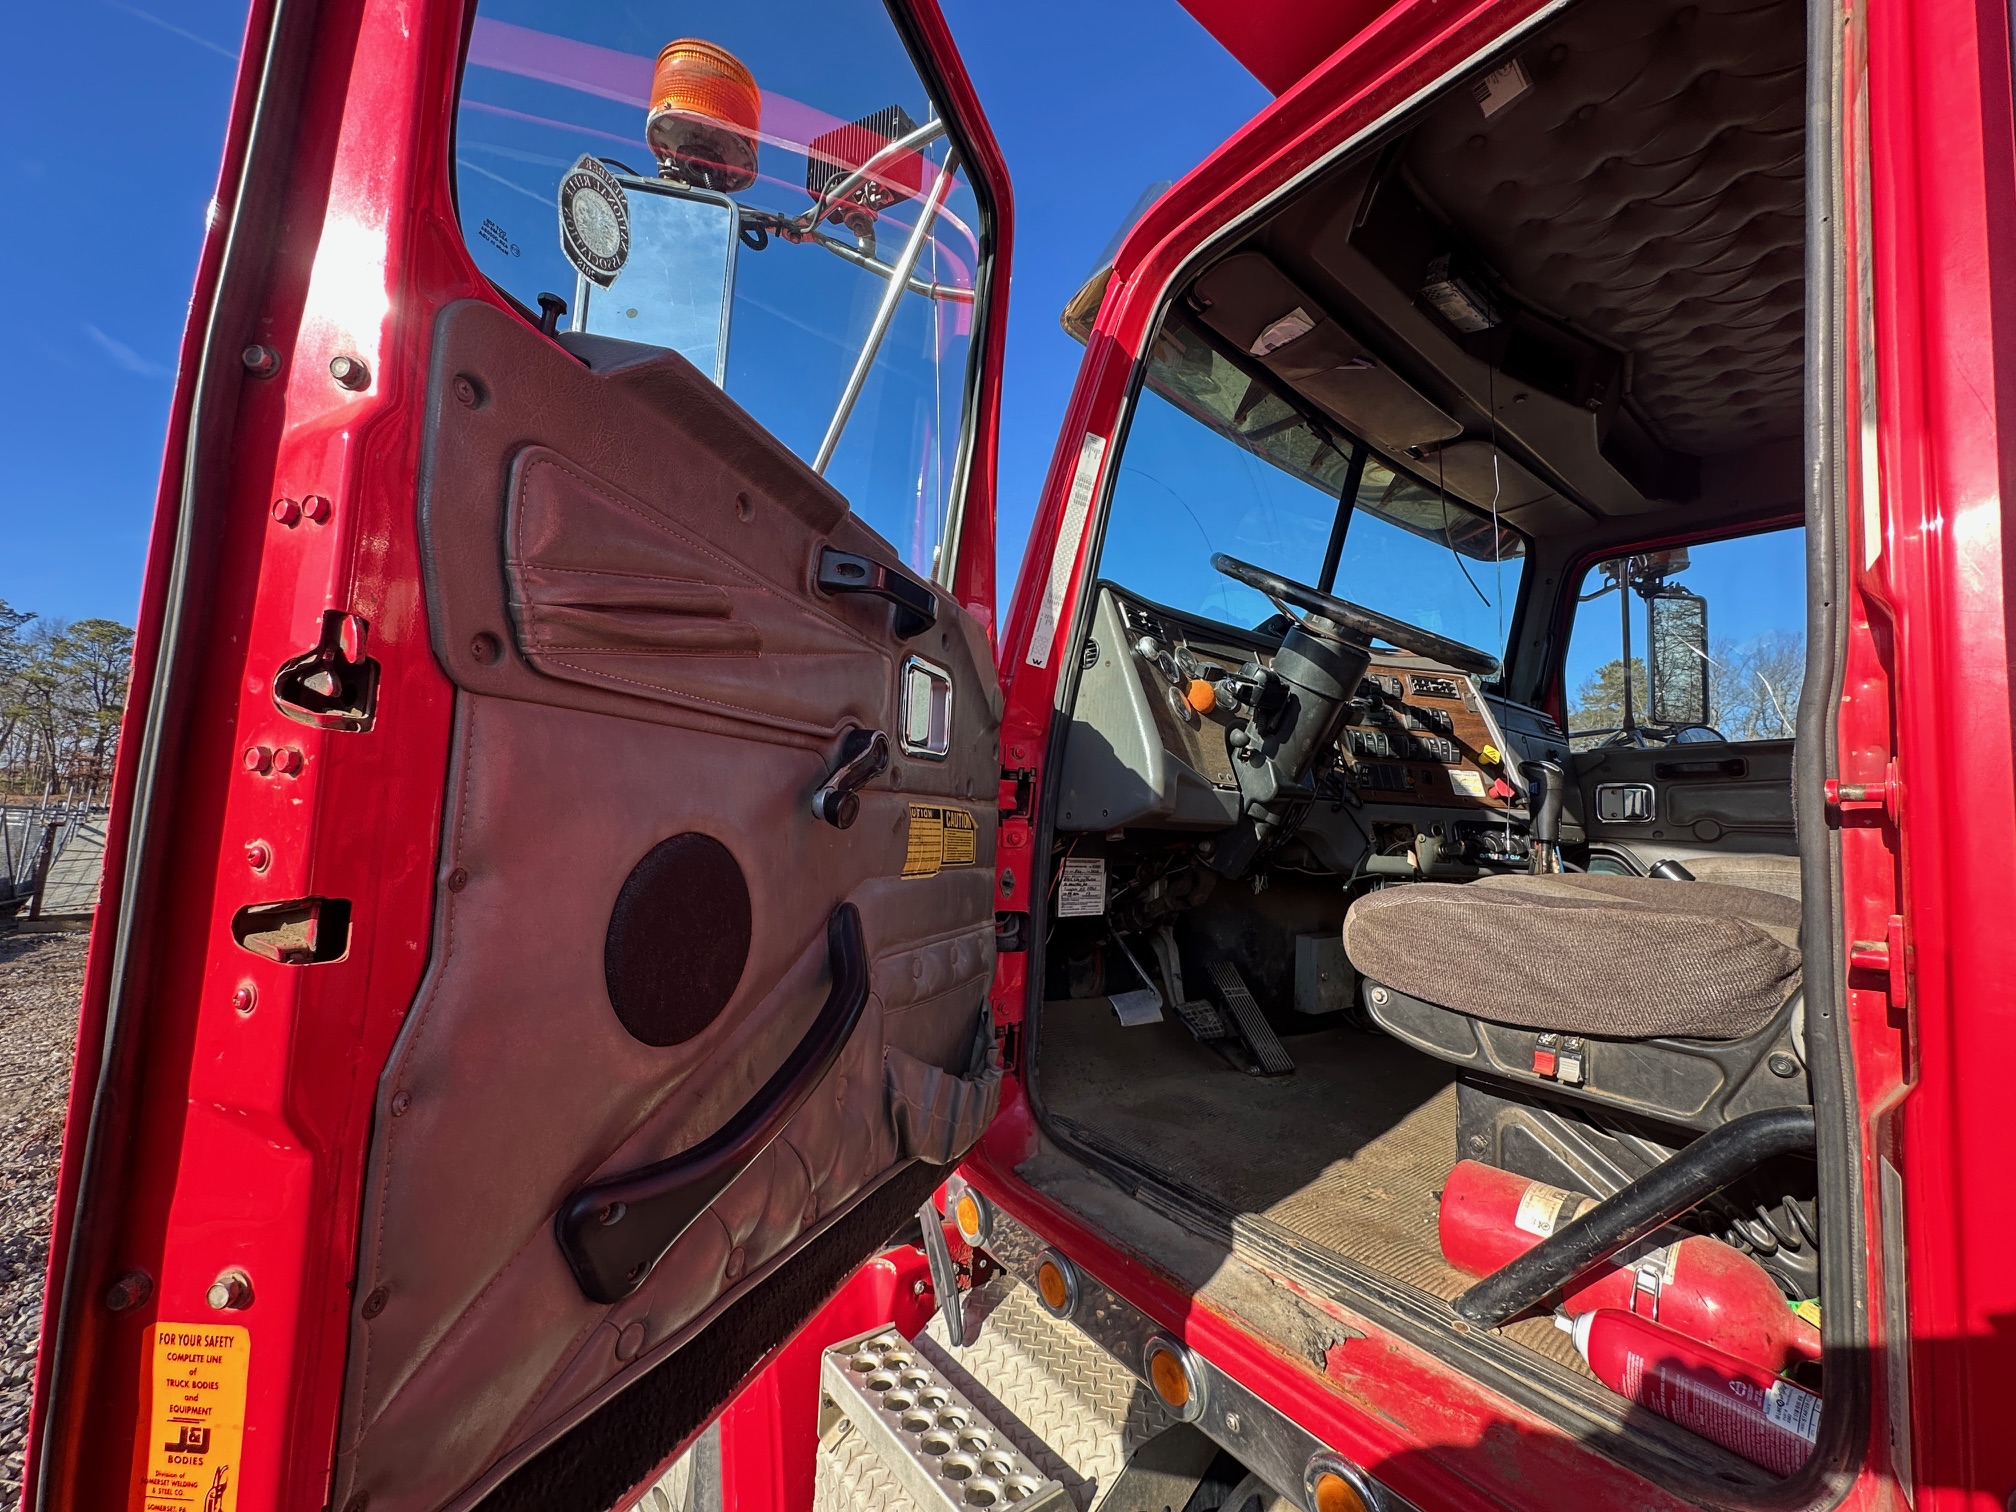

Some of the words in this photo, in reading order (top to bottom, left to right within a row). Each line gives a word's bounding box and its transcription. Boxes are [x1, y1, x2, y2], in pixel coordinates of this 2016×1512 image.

[945, 811, 972, 829] CAUTION
[159, 1333, 176, 1346] FOR
[178, 1333, 202, 1347] YOUR
[204, 1335, 235, 1348] SAFETY
[167, 1352, 204, 1363] COMPLETE
[206, 1354, 222, 1364] LINE
[189, 1368, 197, 1376] of
[166, 1378, 190, 1389] TRUCK
[192, 1380, 219, 1390] BODIES
[184, 1393, 199, 1402] and
[169, 1404, 212, 1416] EQUIPMENT
[168, 1455, 204, 1466] BODIES
[141, 1477, 169, 1486] SOMERSET
